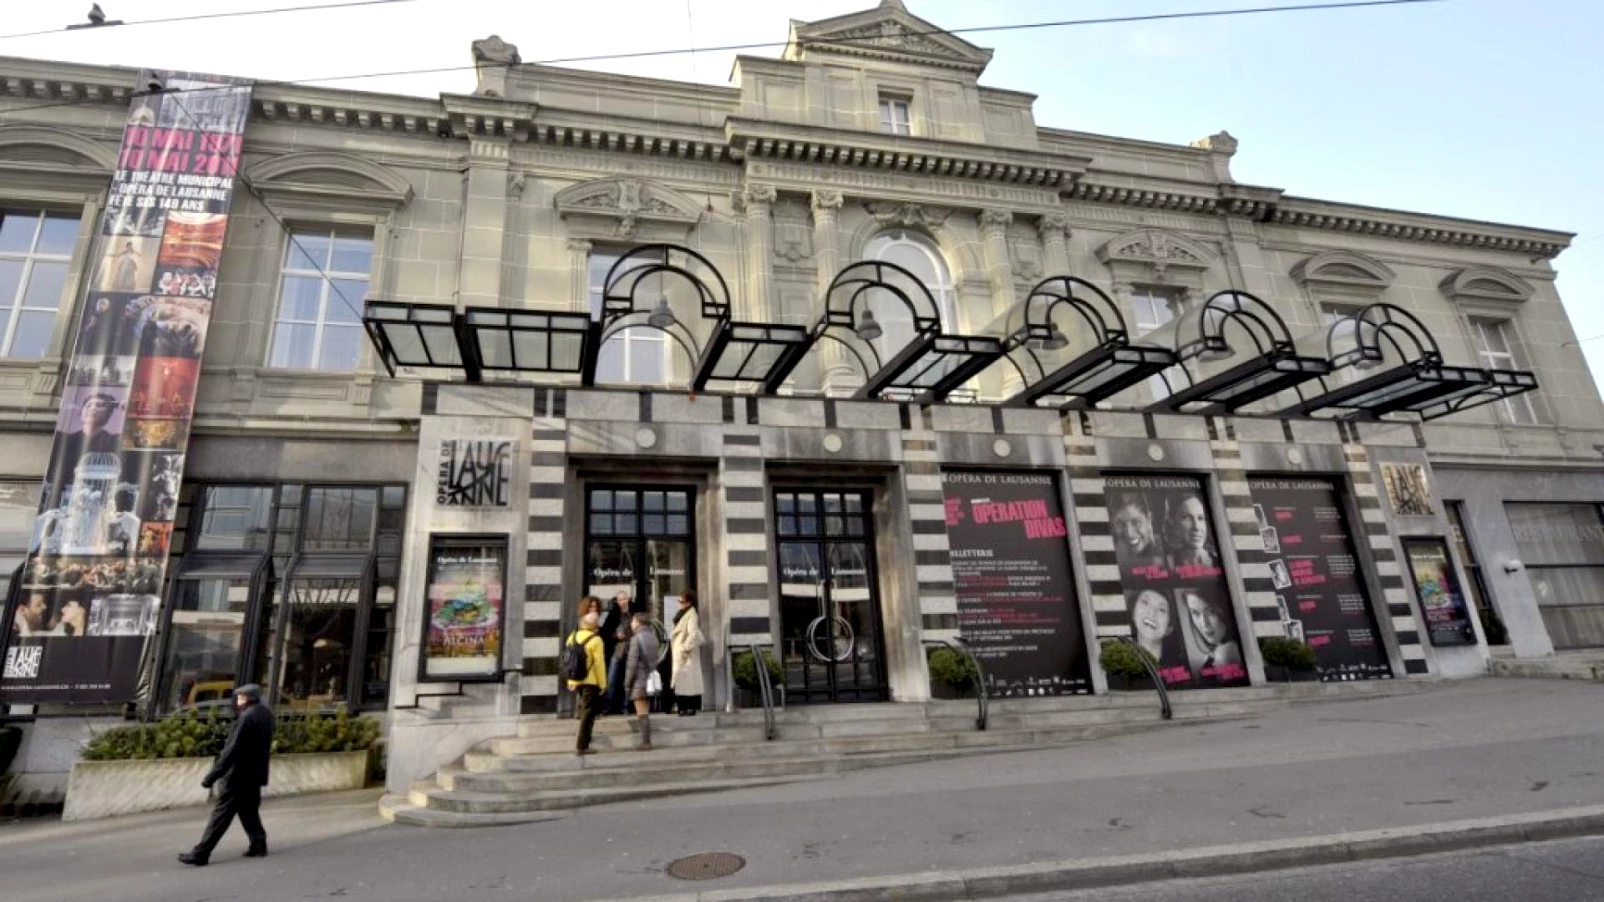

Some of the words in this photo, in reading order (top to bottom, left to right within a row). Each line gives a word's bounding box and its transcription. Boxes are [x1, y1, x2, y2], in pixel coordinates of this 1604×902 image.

[151, 128, 194, 150] MAI
[146, 151, 189, 172] MAI
[177, 174, 233, 189] MUNICIPAL
[172, 186, 229, 201] LAUSANNE
[1000, 475, 1052, 485] LAUSANNE
[1154, 479, 1201, 489] LAUSANNE
[1293, 481, 1334, 490] LAUSANNE
[1023, 516, 1067, 539] DIVAS
[622, 567, 633, 576] de
